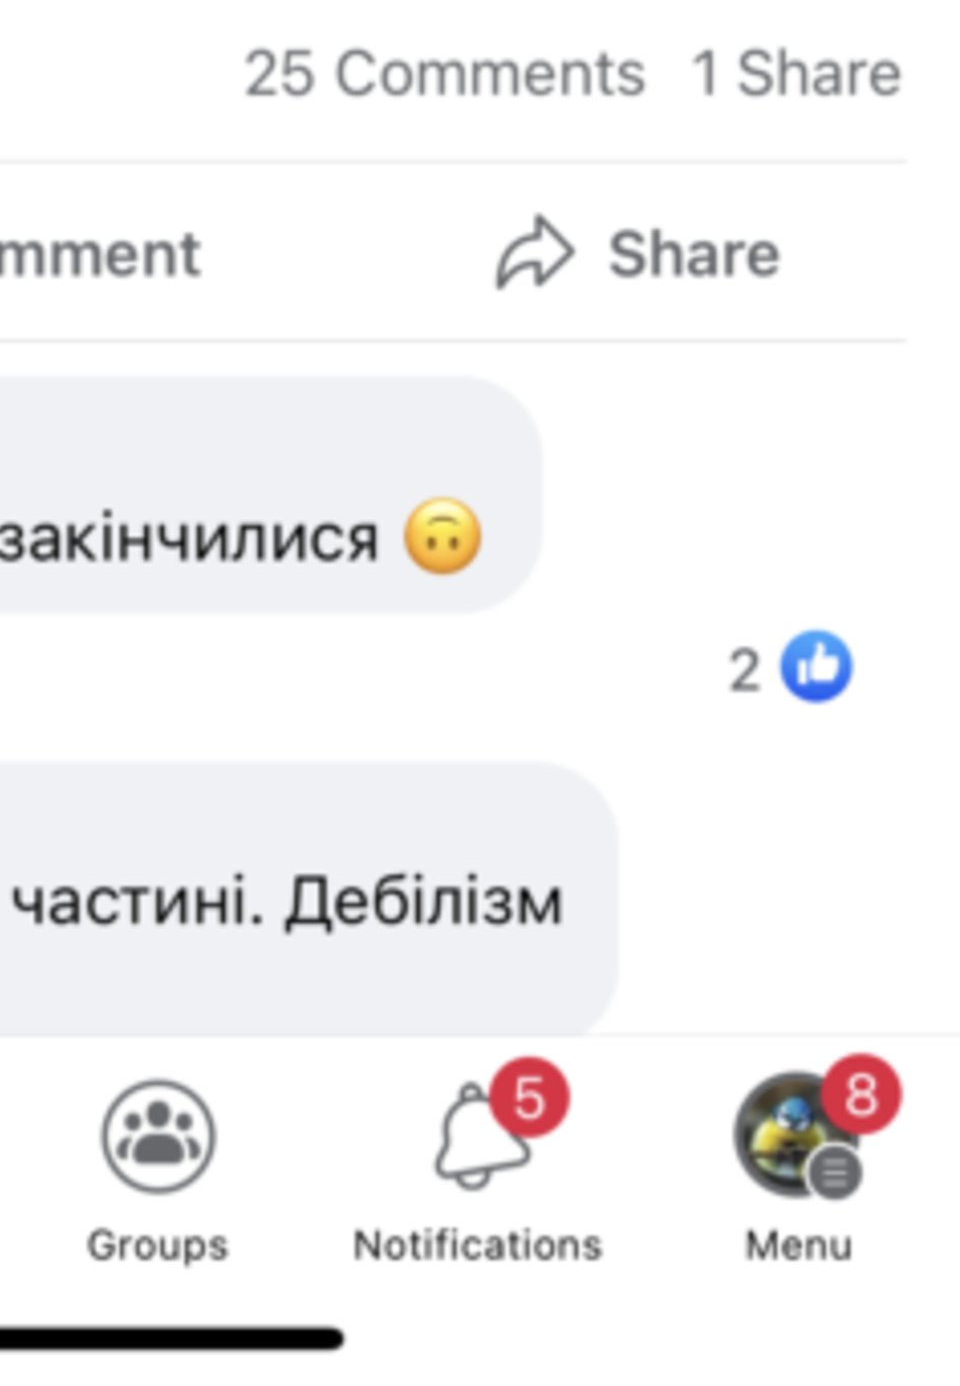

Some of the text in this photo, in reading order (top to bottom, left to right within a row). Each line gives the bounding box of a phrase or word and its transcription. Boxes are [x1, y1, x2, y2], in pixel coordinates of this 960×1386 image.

[246, 48, 645, 97] 25 Comments
[694, 47, 901, 97] 1 Share
[610, 228, 780, 278] Share
[730, 646, 759, 692] 2
[12, 872, 263, 926] частині.
[283, 872, 562, 935] Дебілізм
[516, 1076, 544, 1119] 5
[847, 1073, 876, 1115] 8
[86, 1227, 229, 1267] Groups
[354, 1227, 603, 1262] Notifications
[746, 1228, 852, 1262] Menu
